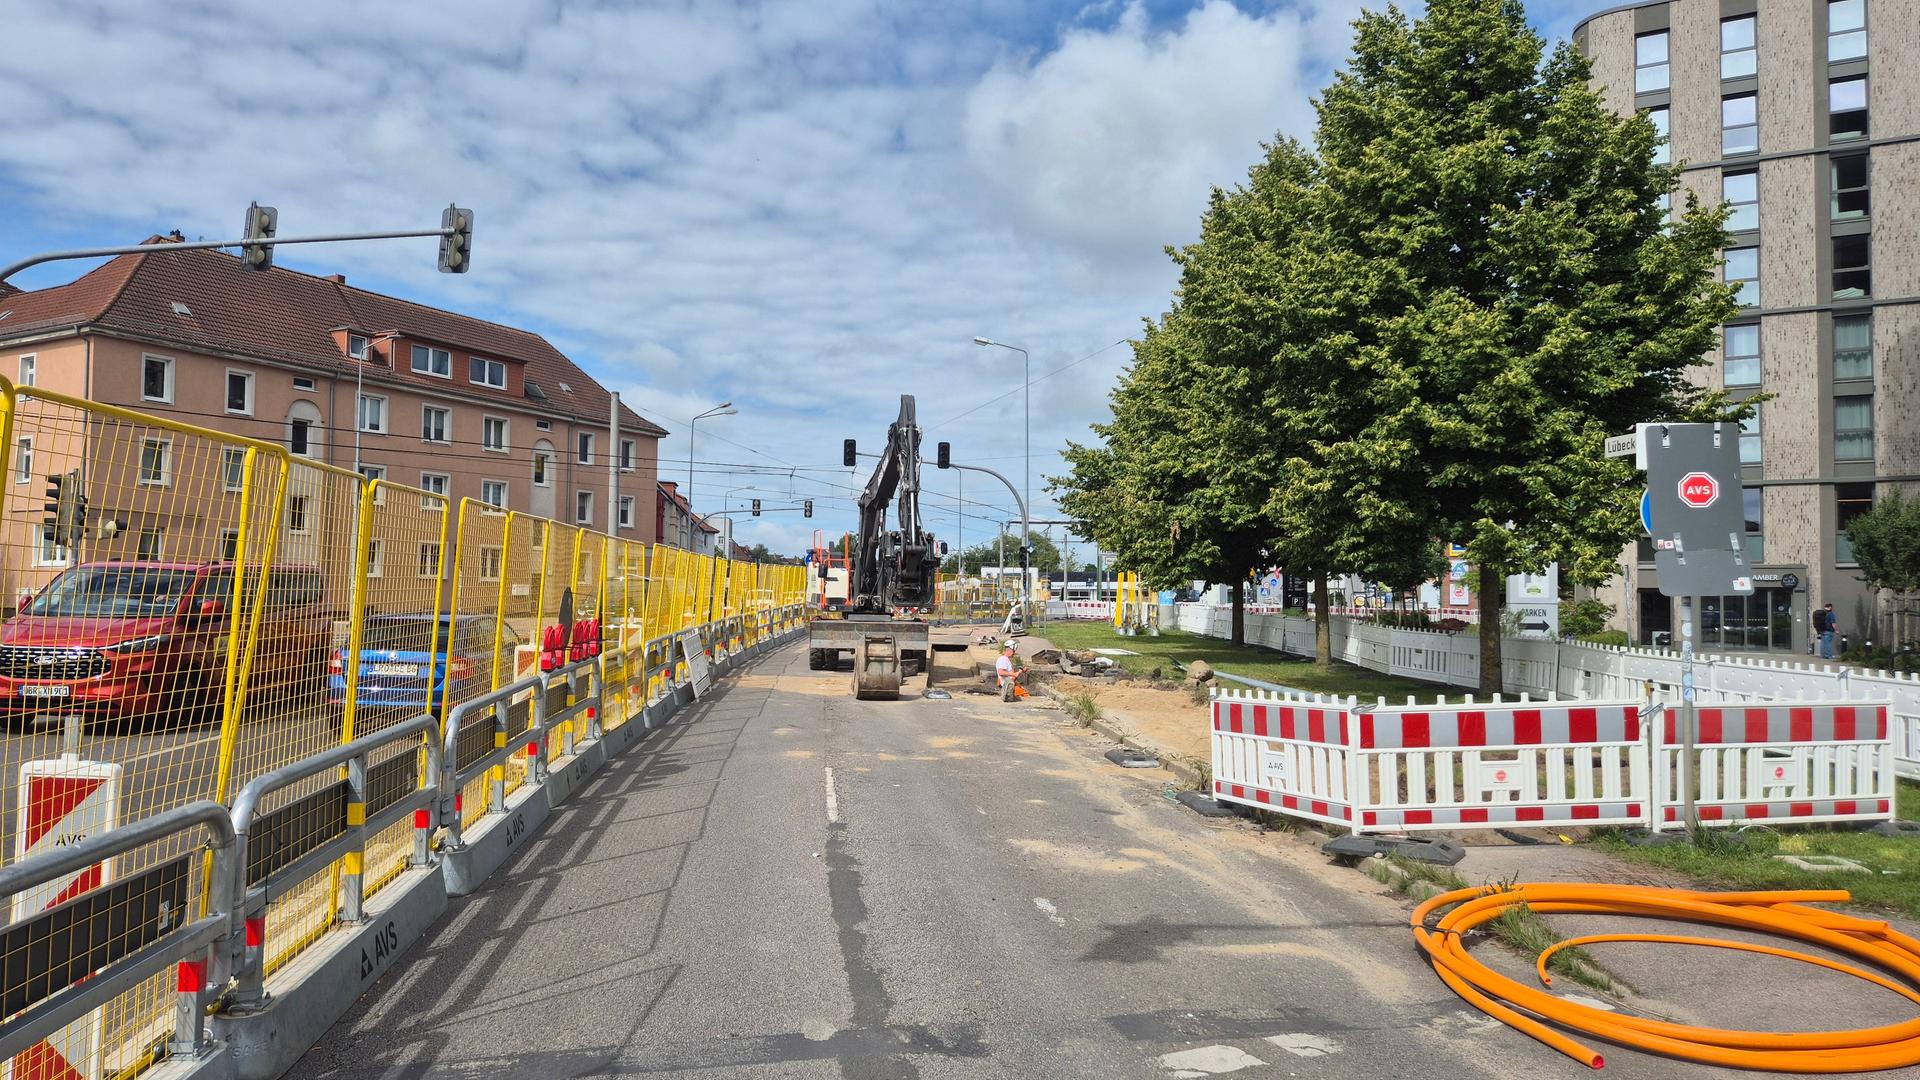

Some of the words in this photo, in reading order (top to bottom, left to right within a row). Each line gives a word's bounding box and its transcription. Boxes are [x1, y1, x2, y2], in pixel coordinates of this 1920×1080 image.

[1686, 485, 1711, 495] AVS
[1274, 762, 1283, 771] AVS
[513, 813, 525, 839] AVS
[375, 921, 398, 966] AVS
